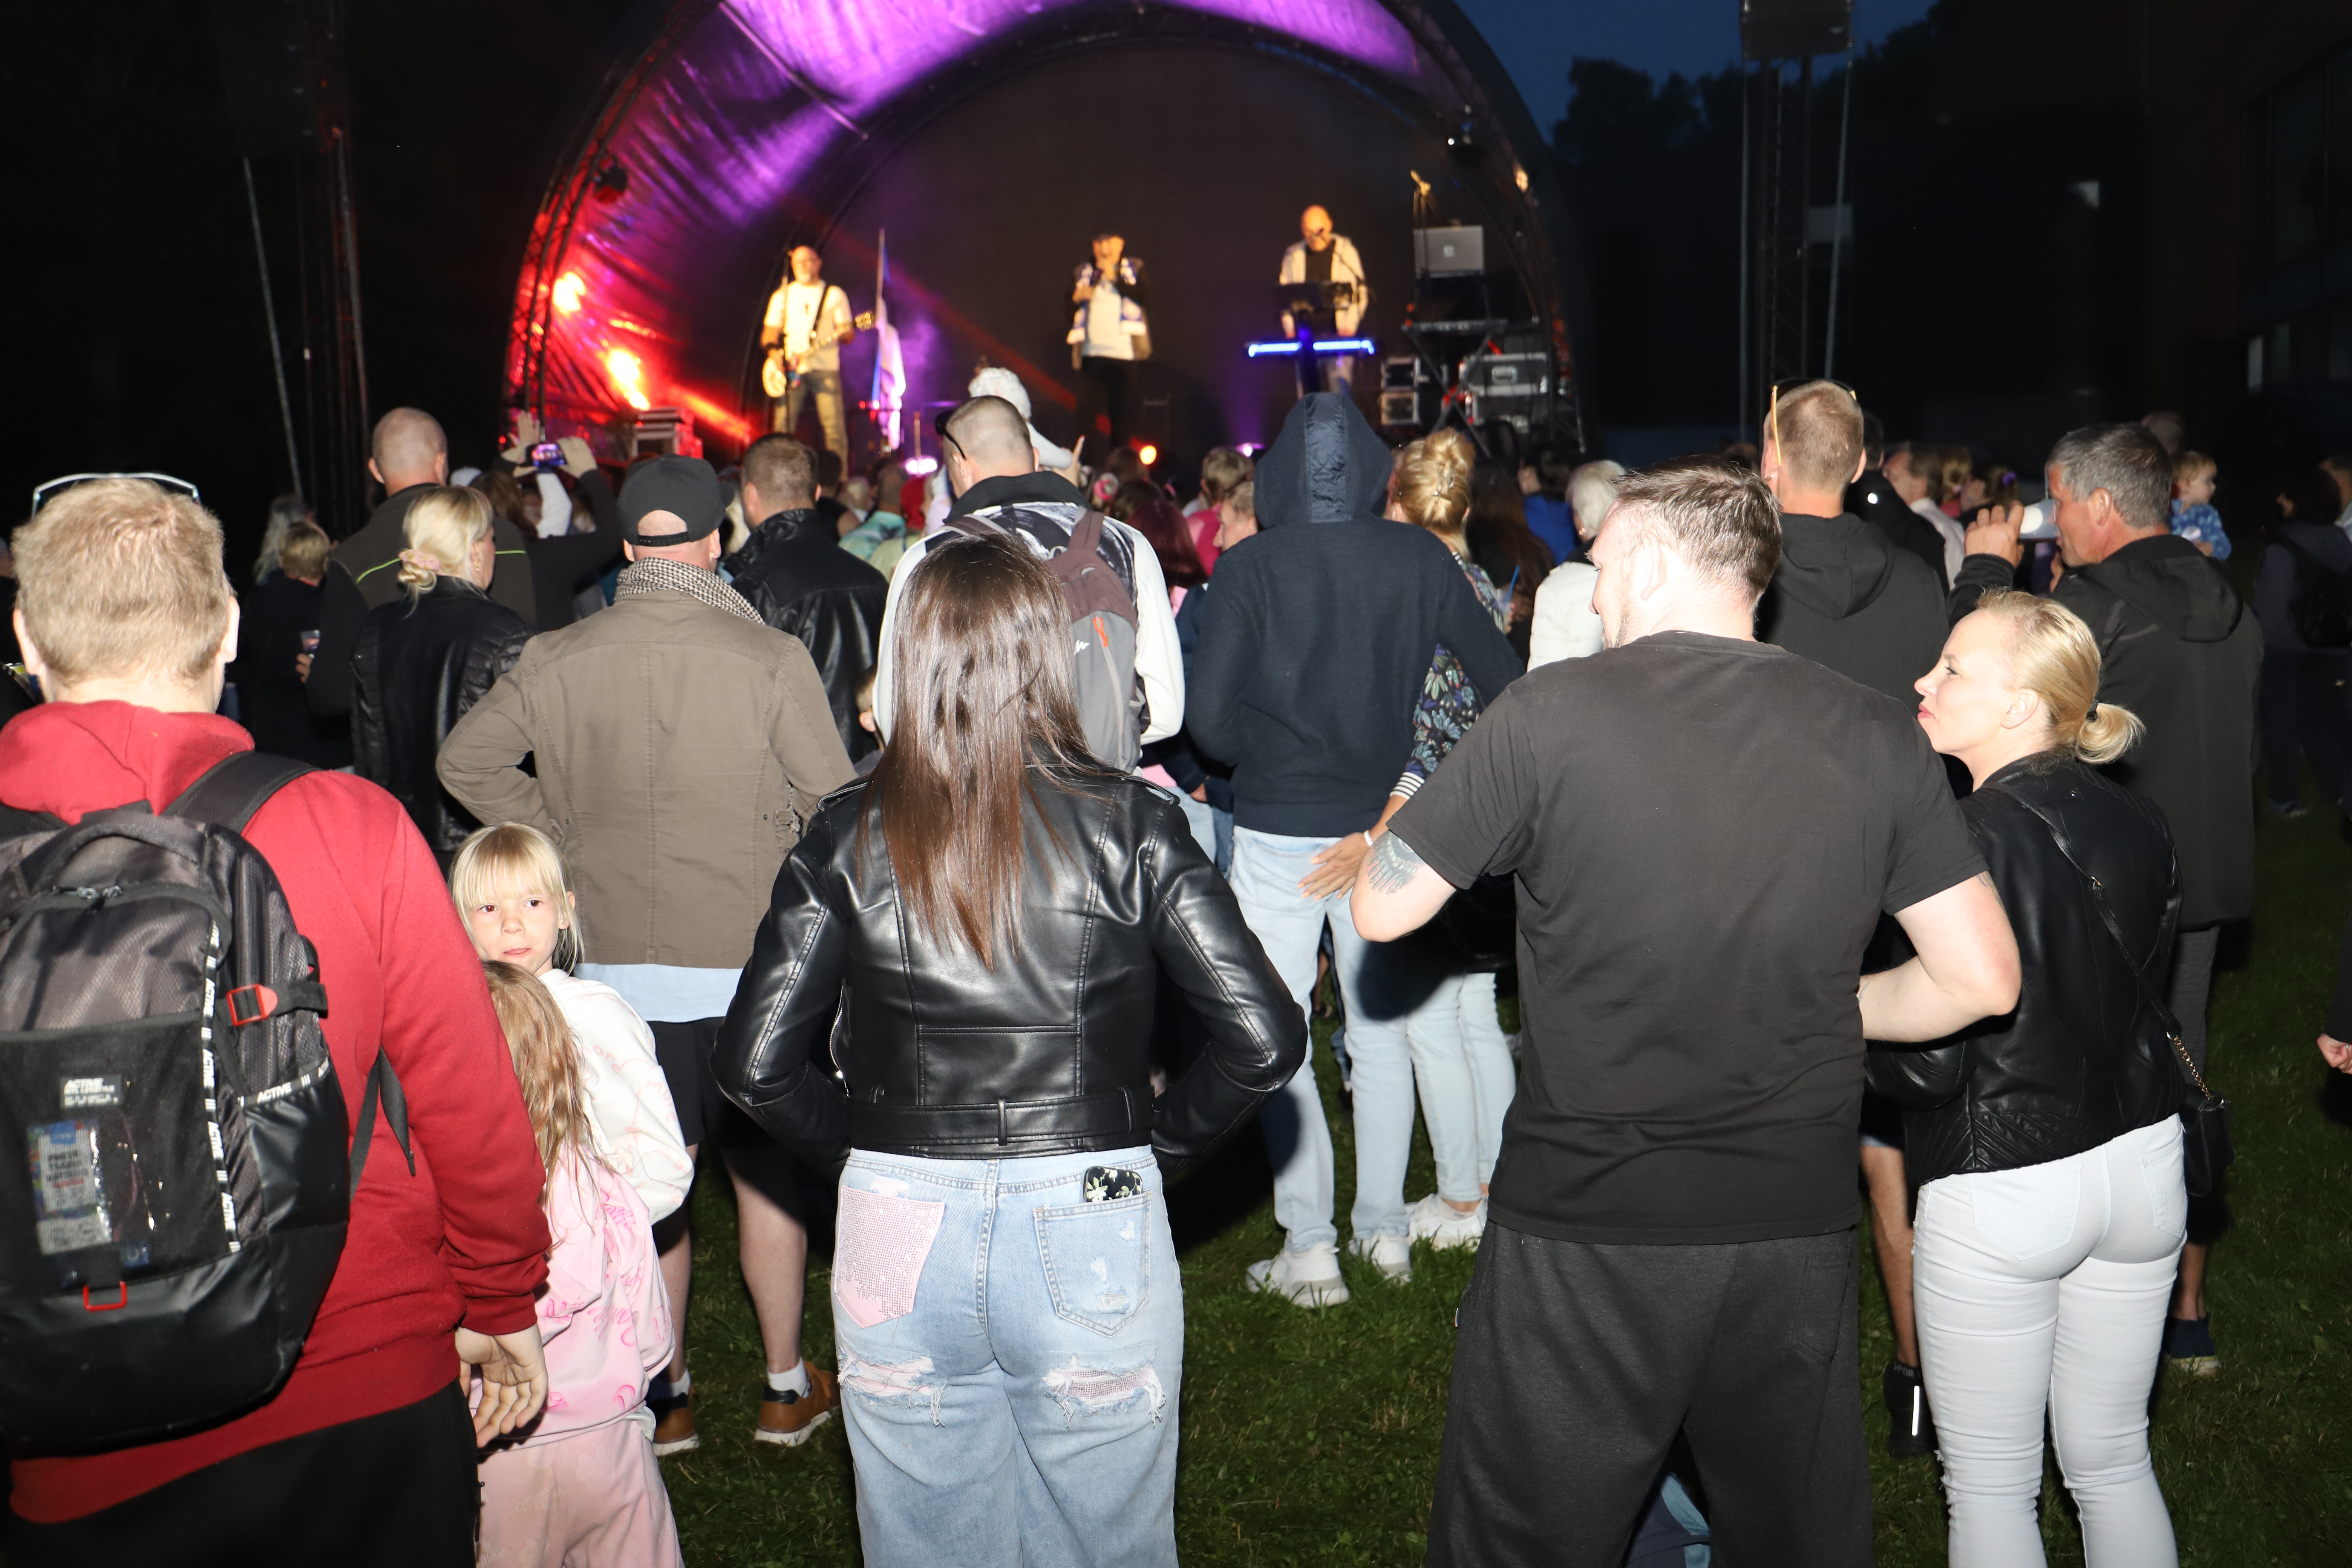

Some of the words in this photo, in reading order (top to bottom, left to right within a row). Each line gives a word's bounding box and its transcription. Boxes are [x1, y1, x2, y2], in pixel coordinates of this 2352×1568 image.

[203, 977, 216, 1018] ACTIVE
[64, 1077, 105, 1088] ACTIVE
[202, 1048, 215, 1089] ACTIVE
[257, 1081, 293, 1104] ACTIVE
[208, 1121, 225, 1161] ACTIVE
[221, 1192, 237, 1231] ACTIVE
